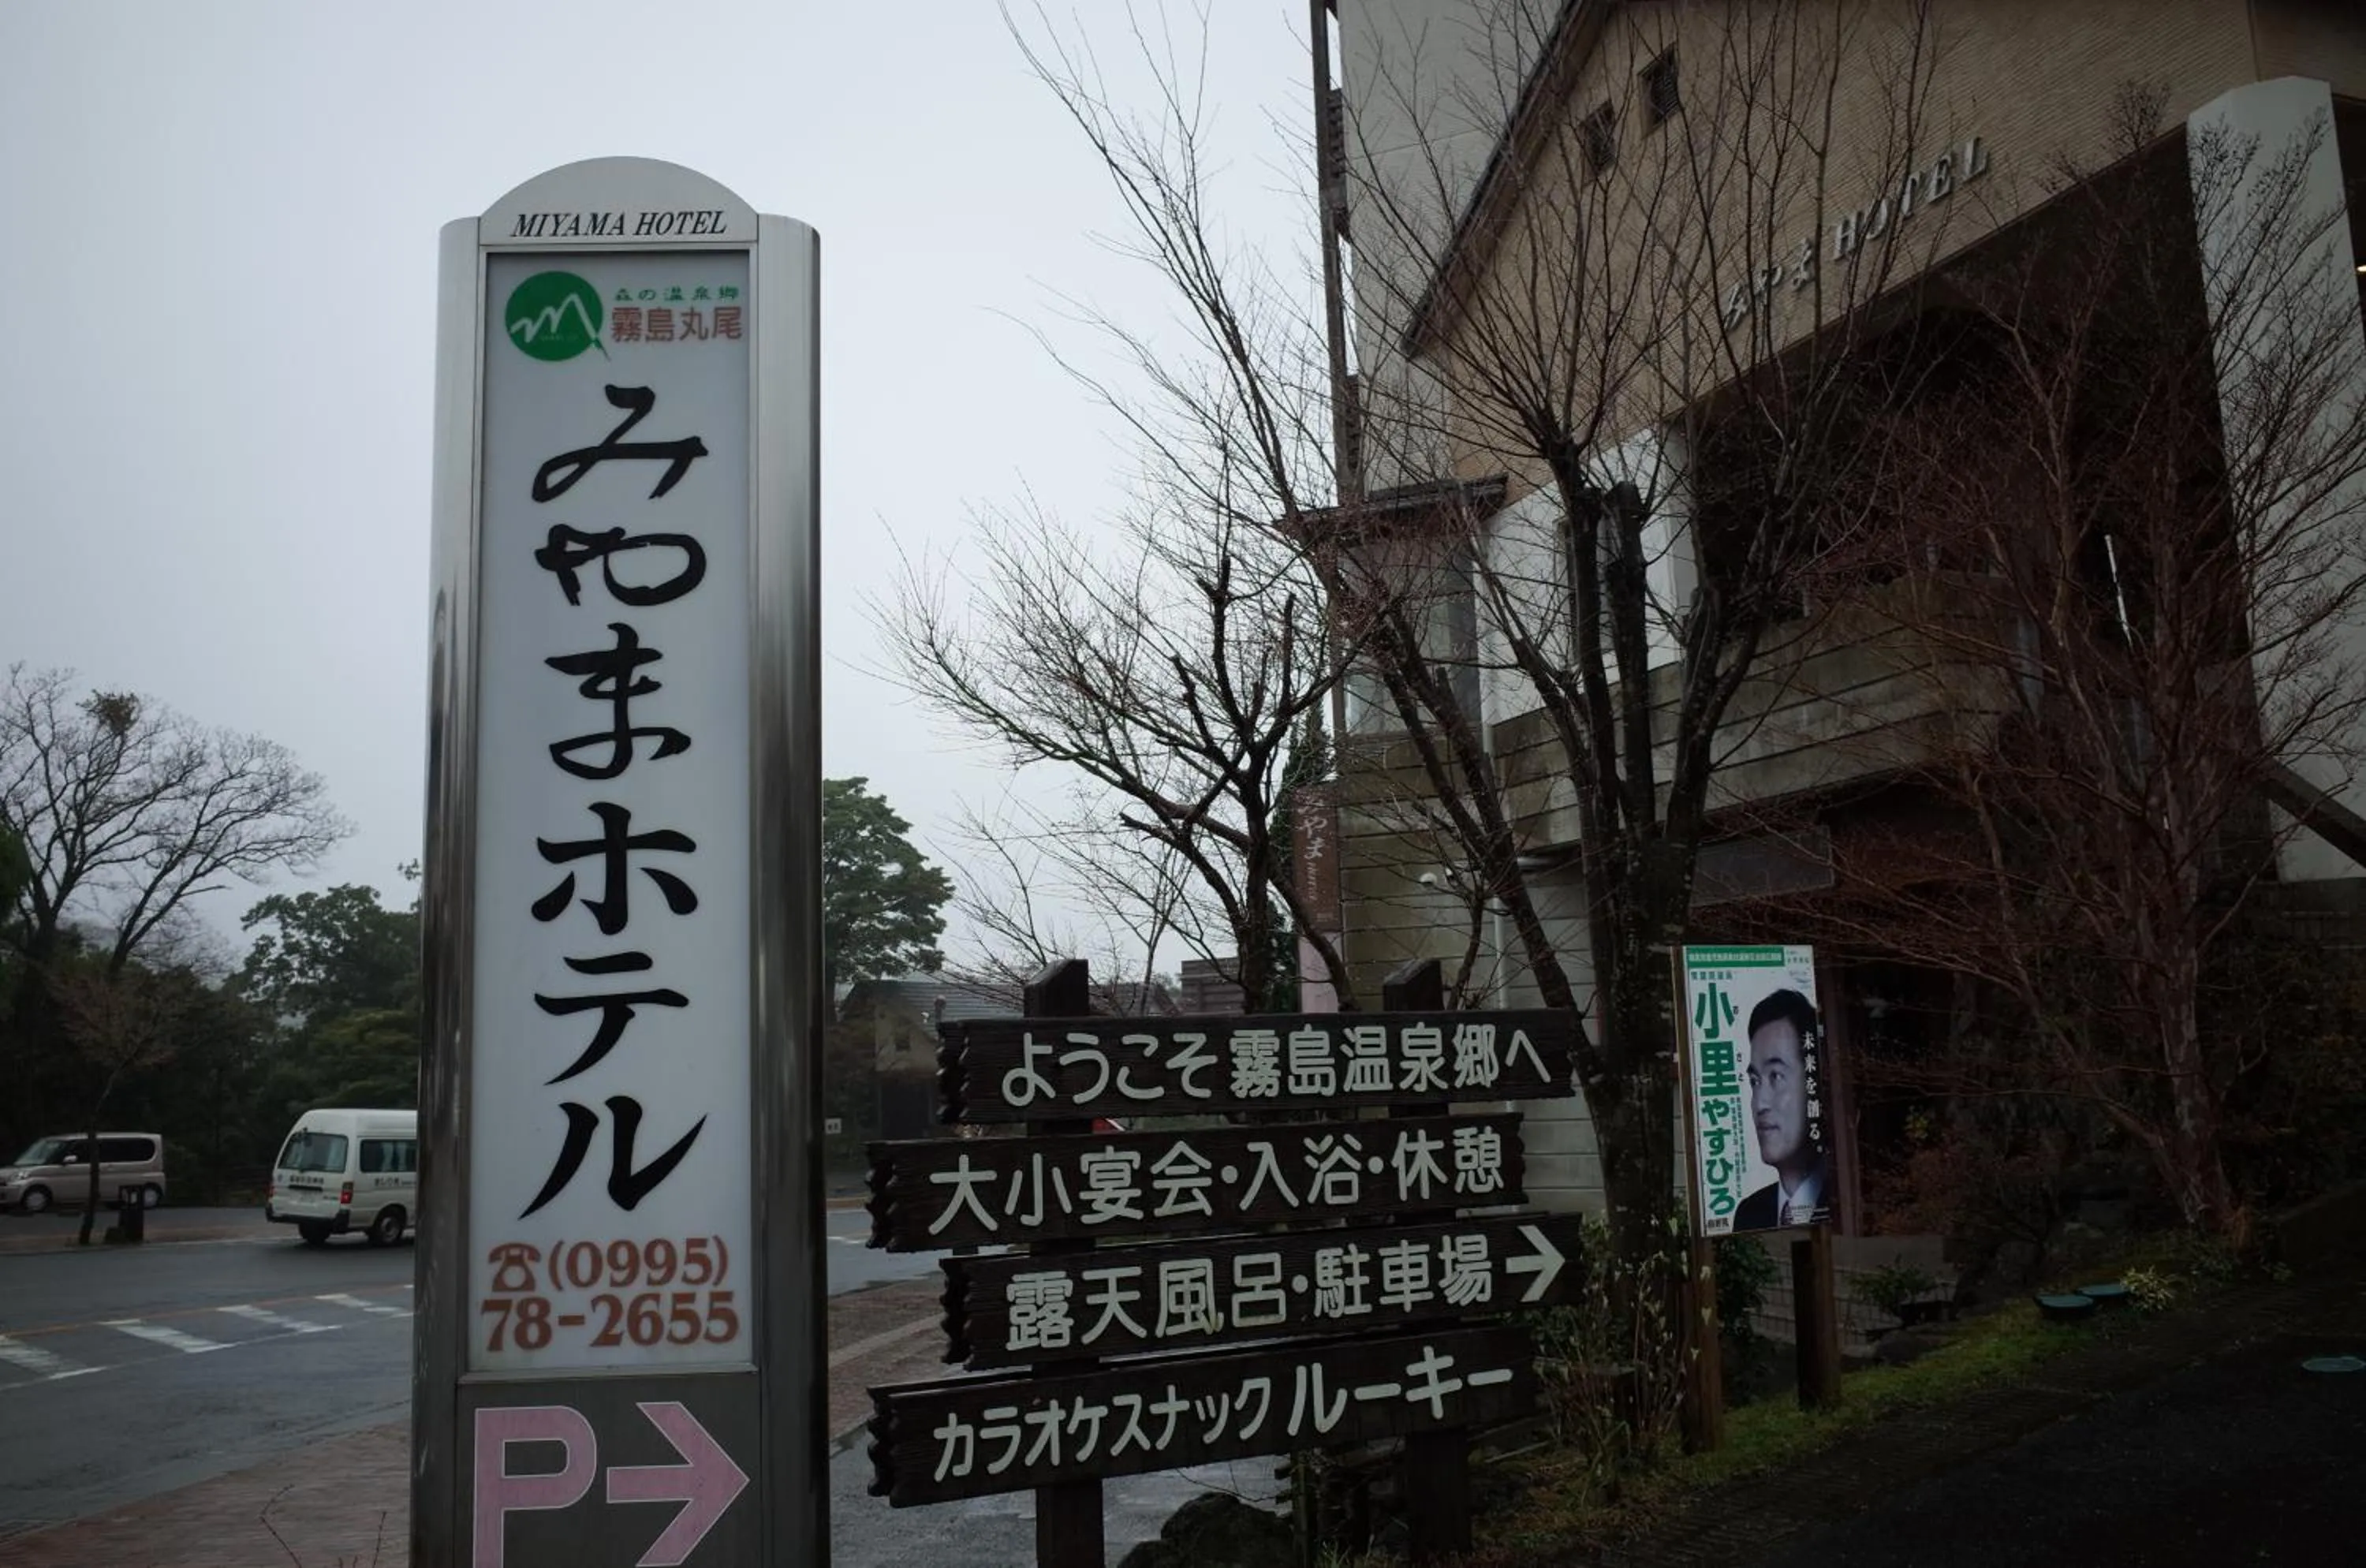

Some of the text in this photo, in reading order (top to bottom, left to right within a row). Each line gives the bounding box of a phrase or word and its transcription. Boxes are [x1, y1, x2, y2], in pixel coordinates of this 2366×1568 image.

[511, 210, 727, 237] MIYAMA HOTEL
[1834, 136, 1990, 261] HOTEL
[611, 305, 743, 342] 霧島丸尾
[519, 384, 709, 1220] みやまホテル
[1002, 1022, 1552, 1106] ようこそ霧島温泉郷へ
[1694, 982, 1741, 1216] 小里やすひろ
[548, 1235, 730, 1291] (0995)
[481, 1291, 740, 1353] 78-2655
